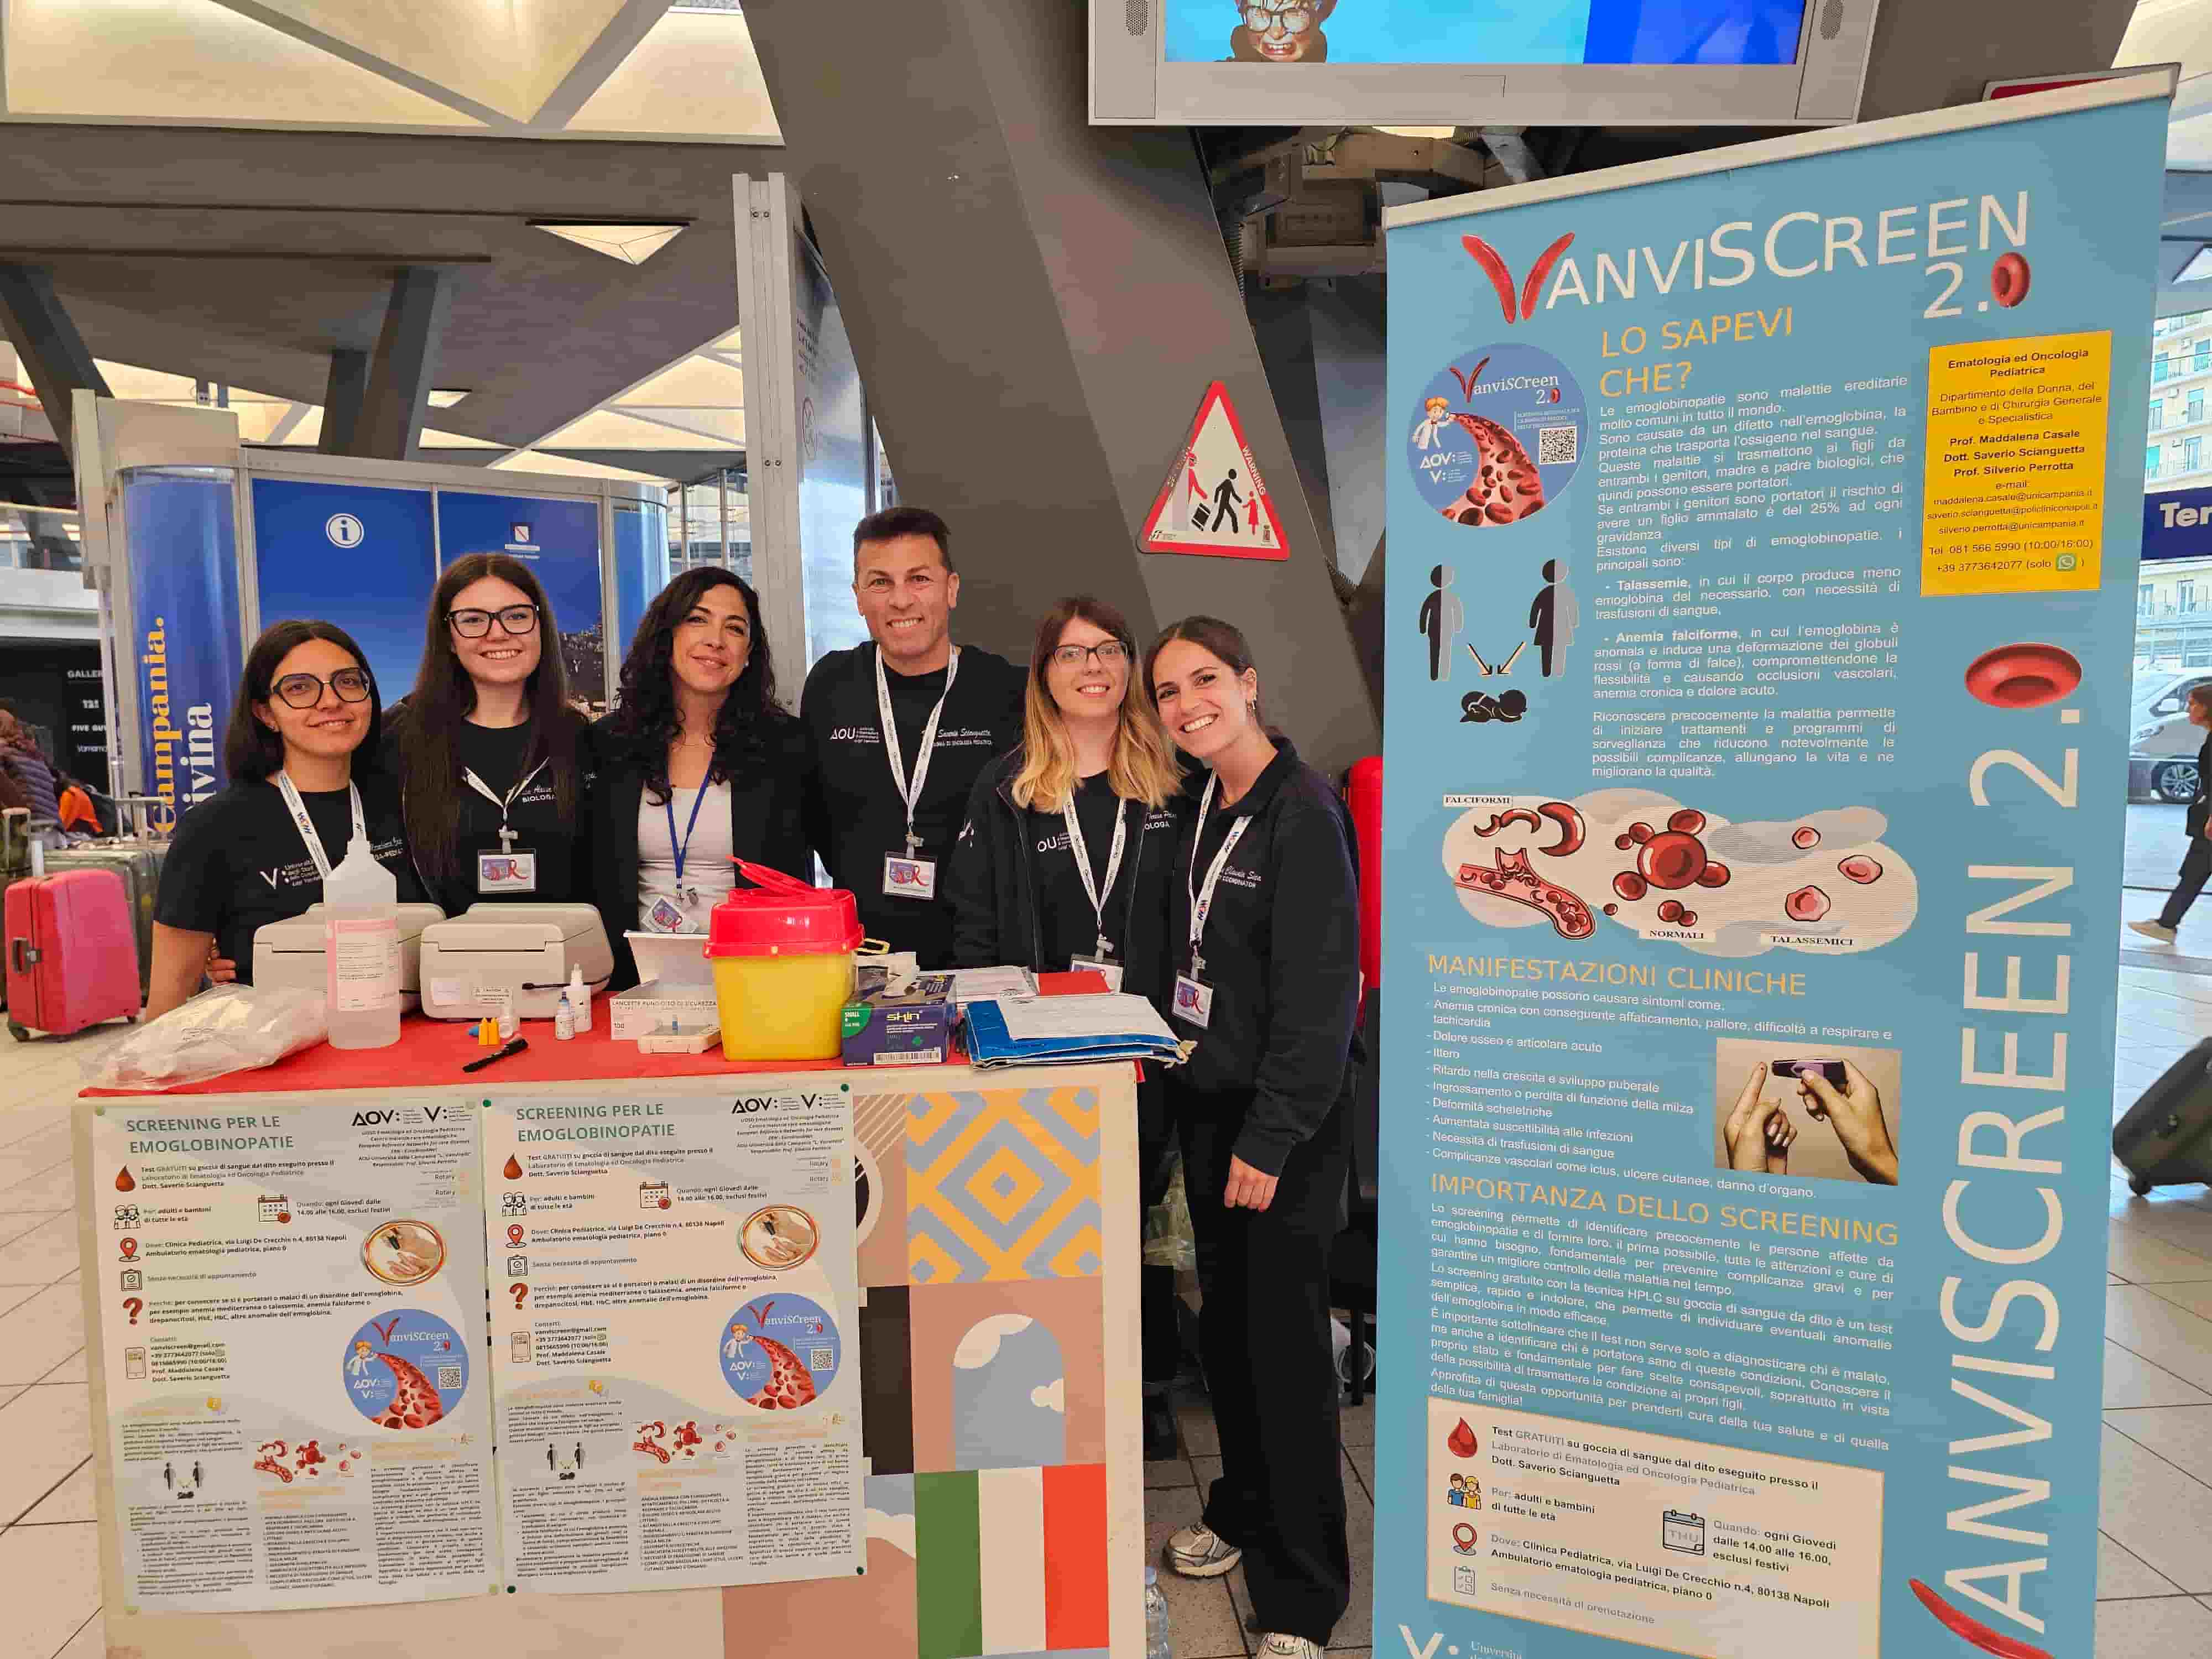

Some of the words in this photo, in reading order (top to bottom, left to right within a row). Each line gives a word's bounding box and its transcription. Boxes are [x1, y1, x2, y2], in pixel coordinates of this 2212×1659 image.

[1601, 327, 1646, 358] LO
[1662, 306, 1792, 349] SAPEVI
[1948, 355, 2010, 369] Ematologia
[2014, 354, 2027, 362] ed
[2031, 349, 2088, 361] Oncologia
[1600, 362, 1691, 397] CHE?
[1990, 367, 2045, 378] Pediatrica
[1601, 407, 1615, 416] Le
[1626, 394, 1725, 414] emoglobinopatie
[1739, 391, 1768, 403] sono
[1781, 383, 1832, 398] malattie
[1845, 377, 1907, 391] ereditarie
[1940, 389, 2006, 403] Dipartimento
[2009, 386, 2033, 395] della
[2037, 385, 2074, 394] Donna,
[2078, 382, 2094, 390] del
[1932, 405, 1977, 416] Bambino
[1990, 402, 1999, 410] di
[2002, 398, 2049, 409] Chirurgia
[2053, 395, 2101, 406] Generale
[1988, 412, 2053, 425] Specialistica
[1950, 436, 1975, 447] Prof.
[1980, 434, 2039, 443] Maddalena
[2043, 429, 2080, 439] Casale
[1944, 453, 1969, 462] Dott.
[1974, 450, 2015, 460] Saverio
[2019, 446, 2084, 457] Scianguetta
[1243, 444, 1266, 495] WARNING
[1954, 467, 1979, 477] Prof.
[1984, 465, 2025, 474] Silverio
[2029, 463, 2073, 472] Perrotta
[1949, 545, 1968, 554] 081
[1973, 544, 1991, 552] 566
[1995, 542, 2020, 551] 5990
[1616, 631, 1663, 643] Anemia
[1672, 629, 1741, 641] falciforme,
[1594, 712, 1666, 721] Riconoscere
[1672, 711, 1759, 723] precocemente
[1765, 708, 1775, 719] la
[1781, 708, 1832, 719] malattia
[1837, 708, 1896, 721] permette
[179, 702, 216, 811] ivina
[1592, 765, 1652, 778] migliorano
[1656, 766, 1666, 776] la
[1670, 765, 1715, 778] qualità.
[1144, 822, 1170, 830] OLOGA
[1037, 837, 1057, 852] OU
[1771, 936, 1853, 946] TALASSEMICI
[1428, 955, 1655, 985] MANIFESTAZIONI
[1668, 968, 1804, 996] CLINICHE
[517, 1106, 607, 1120] SCREENING
[613, 1105, 641, 1117] PER
[646, 1104, 664, 1115] LE
[127, 1118, 221, 1132] SCREENING
[226, 1117, 257, 1129] PER
[262, 1116, 280, 1127] LE
[518, 1124, 675, 1141] EMOGLOBINOPATIE
[130, 1136, 294, 1154] EMOGLOBINOPATIE
[1432, 1173, 1605, 1212] IMPORTANZA
[1617, 1193, 1709, 1227] DELLO
[1721, 1206, 1899, 1246] SCREENING
[1431, 1383, 1455, 1394] della
[1459, 1387, 1475, 1398] tua
[1478, 1390, 1522, 1406] famiglia!
[1492, 1426, 1512, 1437] Test
[1515, 1430, 1564, 1446] GRATUITI
[1583, 1444, 1616, 1455] goccia
[1620, 1448, 1629, 1457] di
[1632, 1453, 1672, 1464] sangue
[1675, 1459, 1691, 1469] dal
[1694, 1462, 1715, 1472] dito
[1719, 1468, 1766, 1480] eseguito
[1770, 1477, 1808, 1488] presso
[1812, 1481, 1818, 1490] il
[1492, 1455, 1515, 1467] Dott.
[1519, 1460, 1556, 1474] Saverio
[1559, 1467, 1619, 1485] Scianguetta
[1492, 1503, 1500, 1511] di
[1504, 1505, 1526, 1515] tutte
[1529, 1509, 1537, 1517] le
[1514, 1493, 1542, 1504] adulti
[1554, 1499, 1594, 1514] bambini
[1667, 1529, 1698, 1543] THU
[1714, 1520, 1761, 1535] Quando:
[1764, 1532, 1789, 1541] ogni
[1713, 1536, 1739, 1547] dalle
[1743, 1541, 1771, 1553] 14.00
[1775, 1548, 1794, 1558] alle
[1713, 1553, 1751, 1565] esclusi
[1755, 1559, 1788, 1572] festivi
[1491, 1549, 1552, 1567] Ambulatorio
[1556, 1564, 1611, 1580] ematologia
[1615, 1575, 1669, 1593] pediatrica,
[1673, 1587, 1703, 1598] piano
[1523, 1541, 1557, 1554] Clinica
[1561, 1548, 1614, 1567] Pediatrica,
[1618, 1561, 1632, 1569] via
[1636, 1562, 1661, 1576] Luigi
[1665, 1568, 1679, 1578] De
[1683, 1572, 1731, 1588] Crecchio
[1757, 1587, 1790, 1600] 80138
[1794, 1594, 1829, 1608] Napoli
